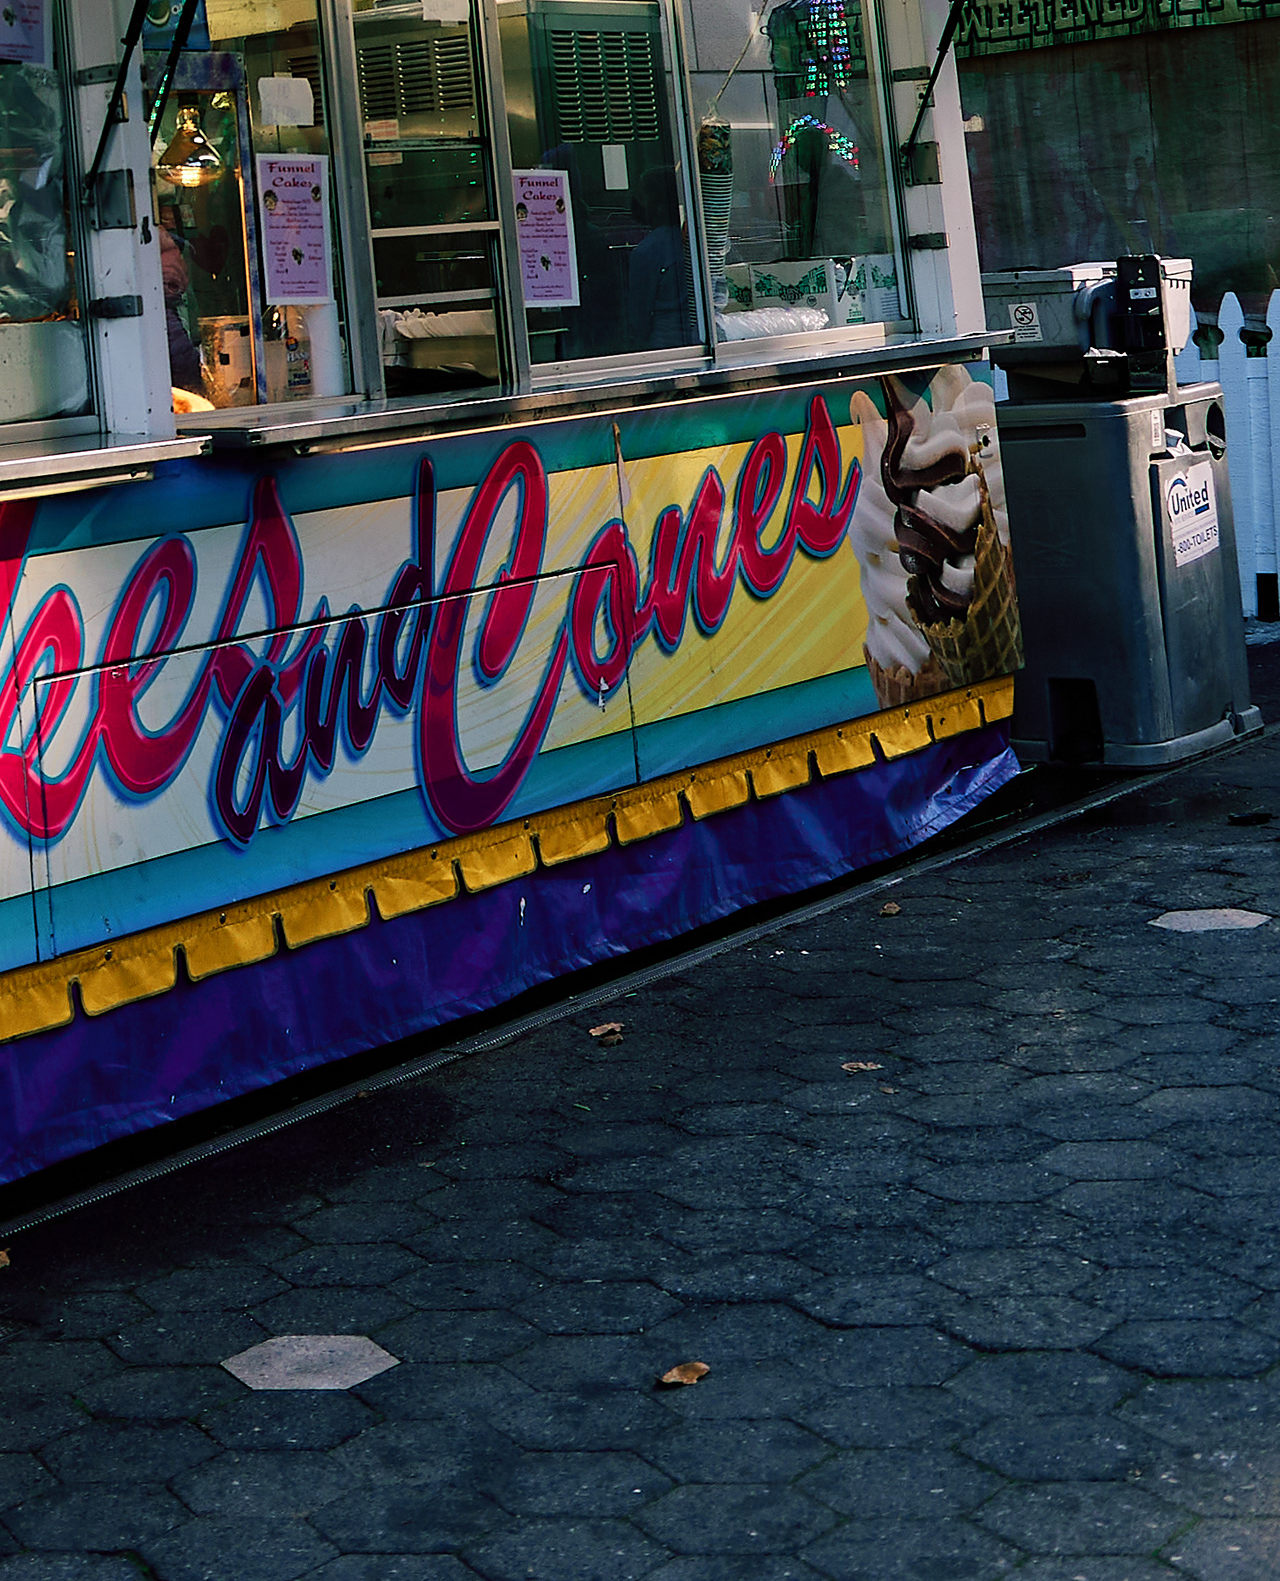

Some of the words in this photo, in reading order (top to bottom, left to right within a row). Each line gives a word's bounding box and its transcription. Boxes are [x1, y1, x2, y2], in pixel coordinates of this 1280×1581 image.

[267, 162, 315, 174] Funnel
[272, 176, 313, 188] Cakes
[519, 177, 559, 188] Funnel
[523, 190, 557, 201] Cakes
[1171, 481, 1209, 516] United
[414, 392, 863, 838] Cones
[214, 453, 438, 850] and
